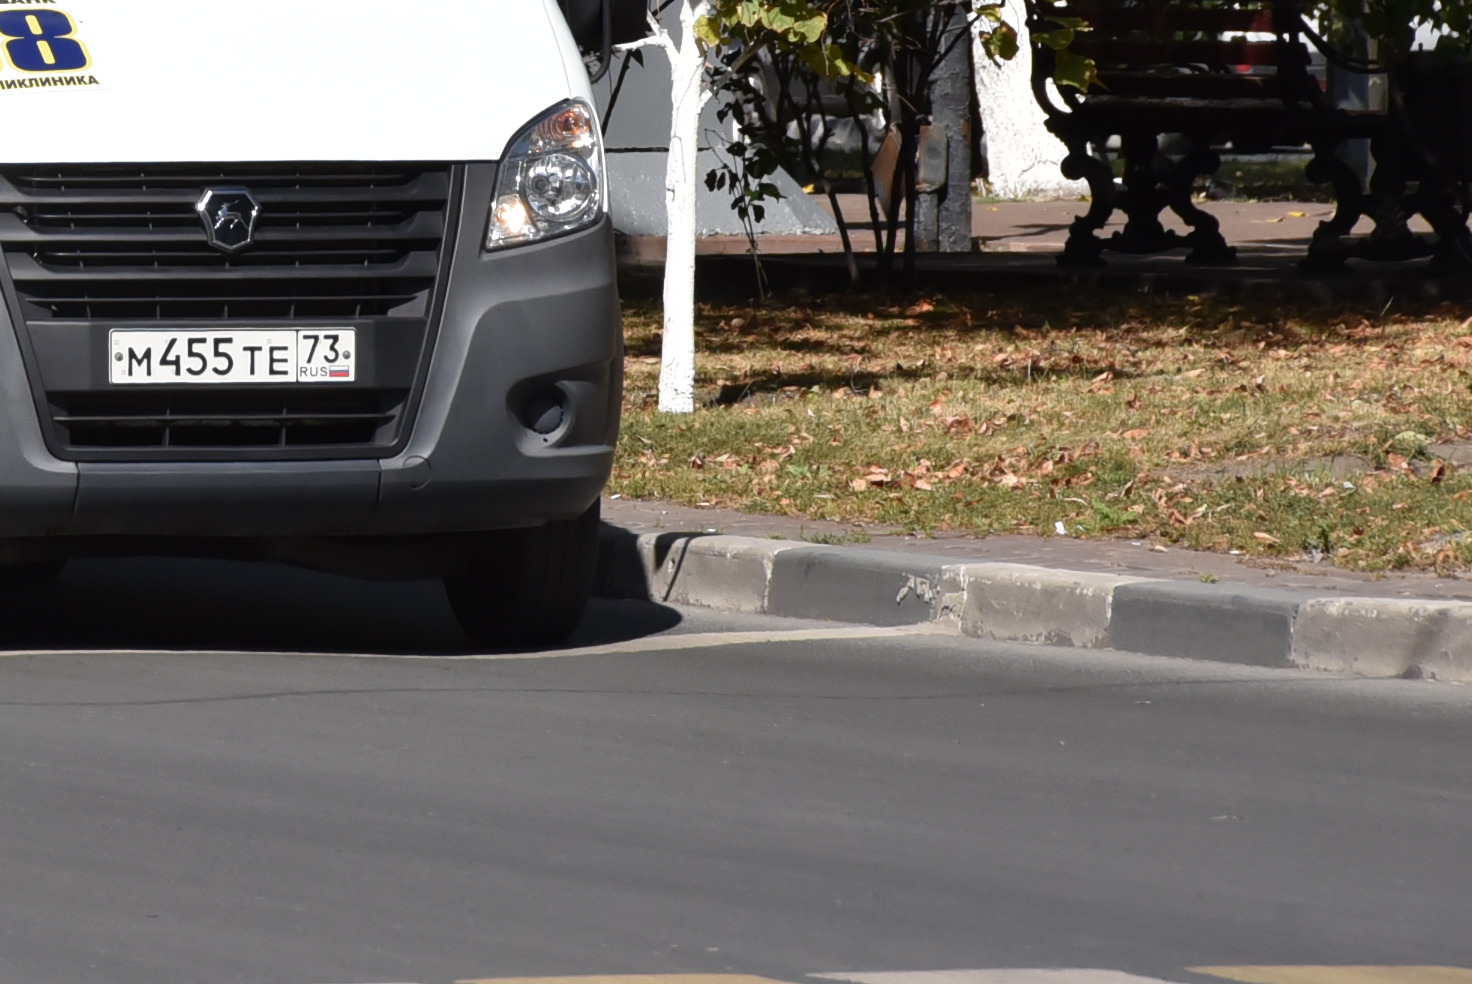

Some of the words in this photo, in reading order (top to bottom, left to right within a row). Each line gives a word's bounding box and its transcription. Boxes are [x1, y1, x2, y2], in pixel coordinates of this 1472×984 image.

[127, 337, 289, 377] М455ТЕ
[302, 334, 340, 364] 73
[299, 366, 328, 377] RUS
